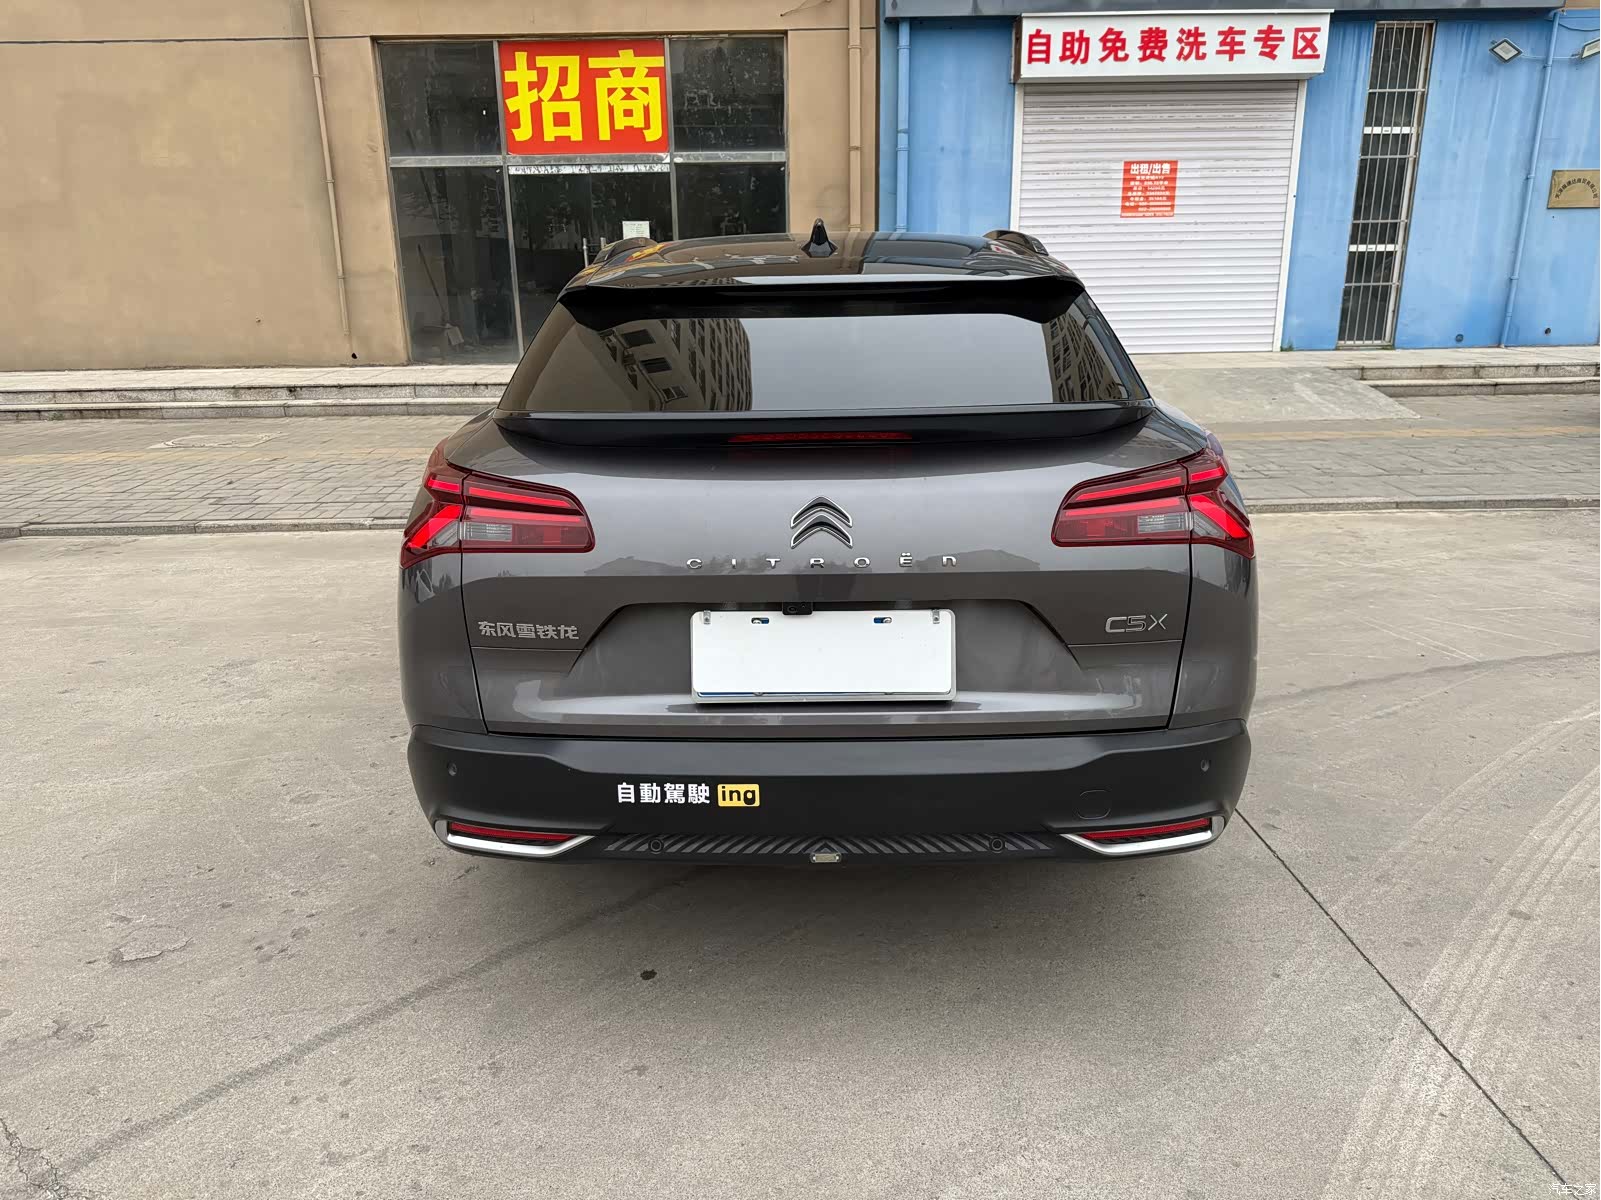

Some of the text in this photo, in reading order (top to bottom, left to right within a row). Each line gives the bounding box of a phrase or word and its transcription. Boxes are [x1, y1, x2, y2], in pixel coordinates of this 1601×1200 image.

[1027, 25, 1321, 65] 自助免费洗车专区
[504, 49, 665, 142] 招商
[1130, 163, 1171, 175] 出租/出售
[478, 621, 580, 640] 东风雪铁龙
[617, 782, 755, 805] 自動駕駛 ing
